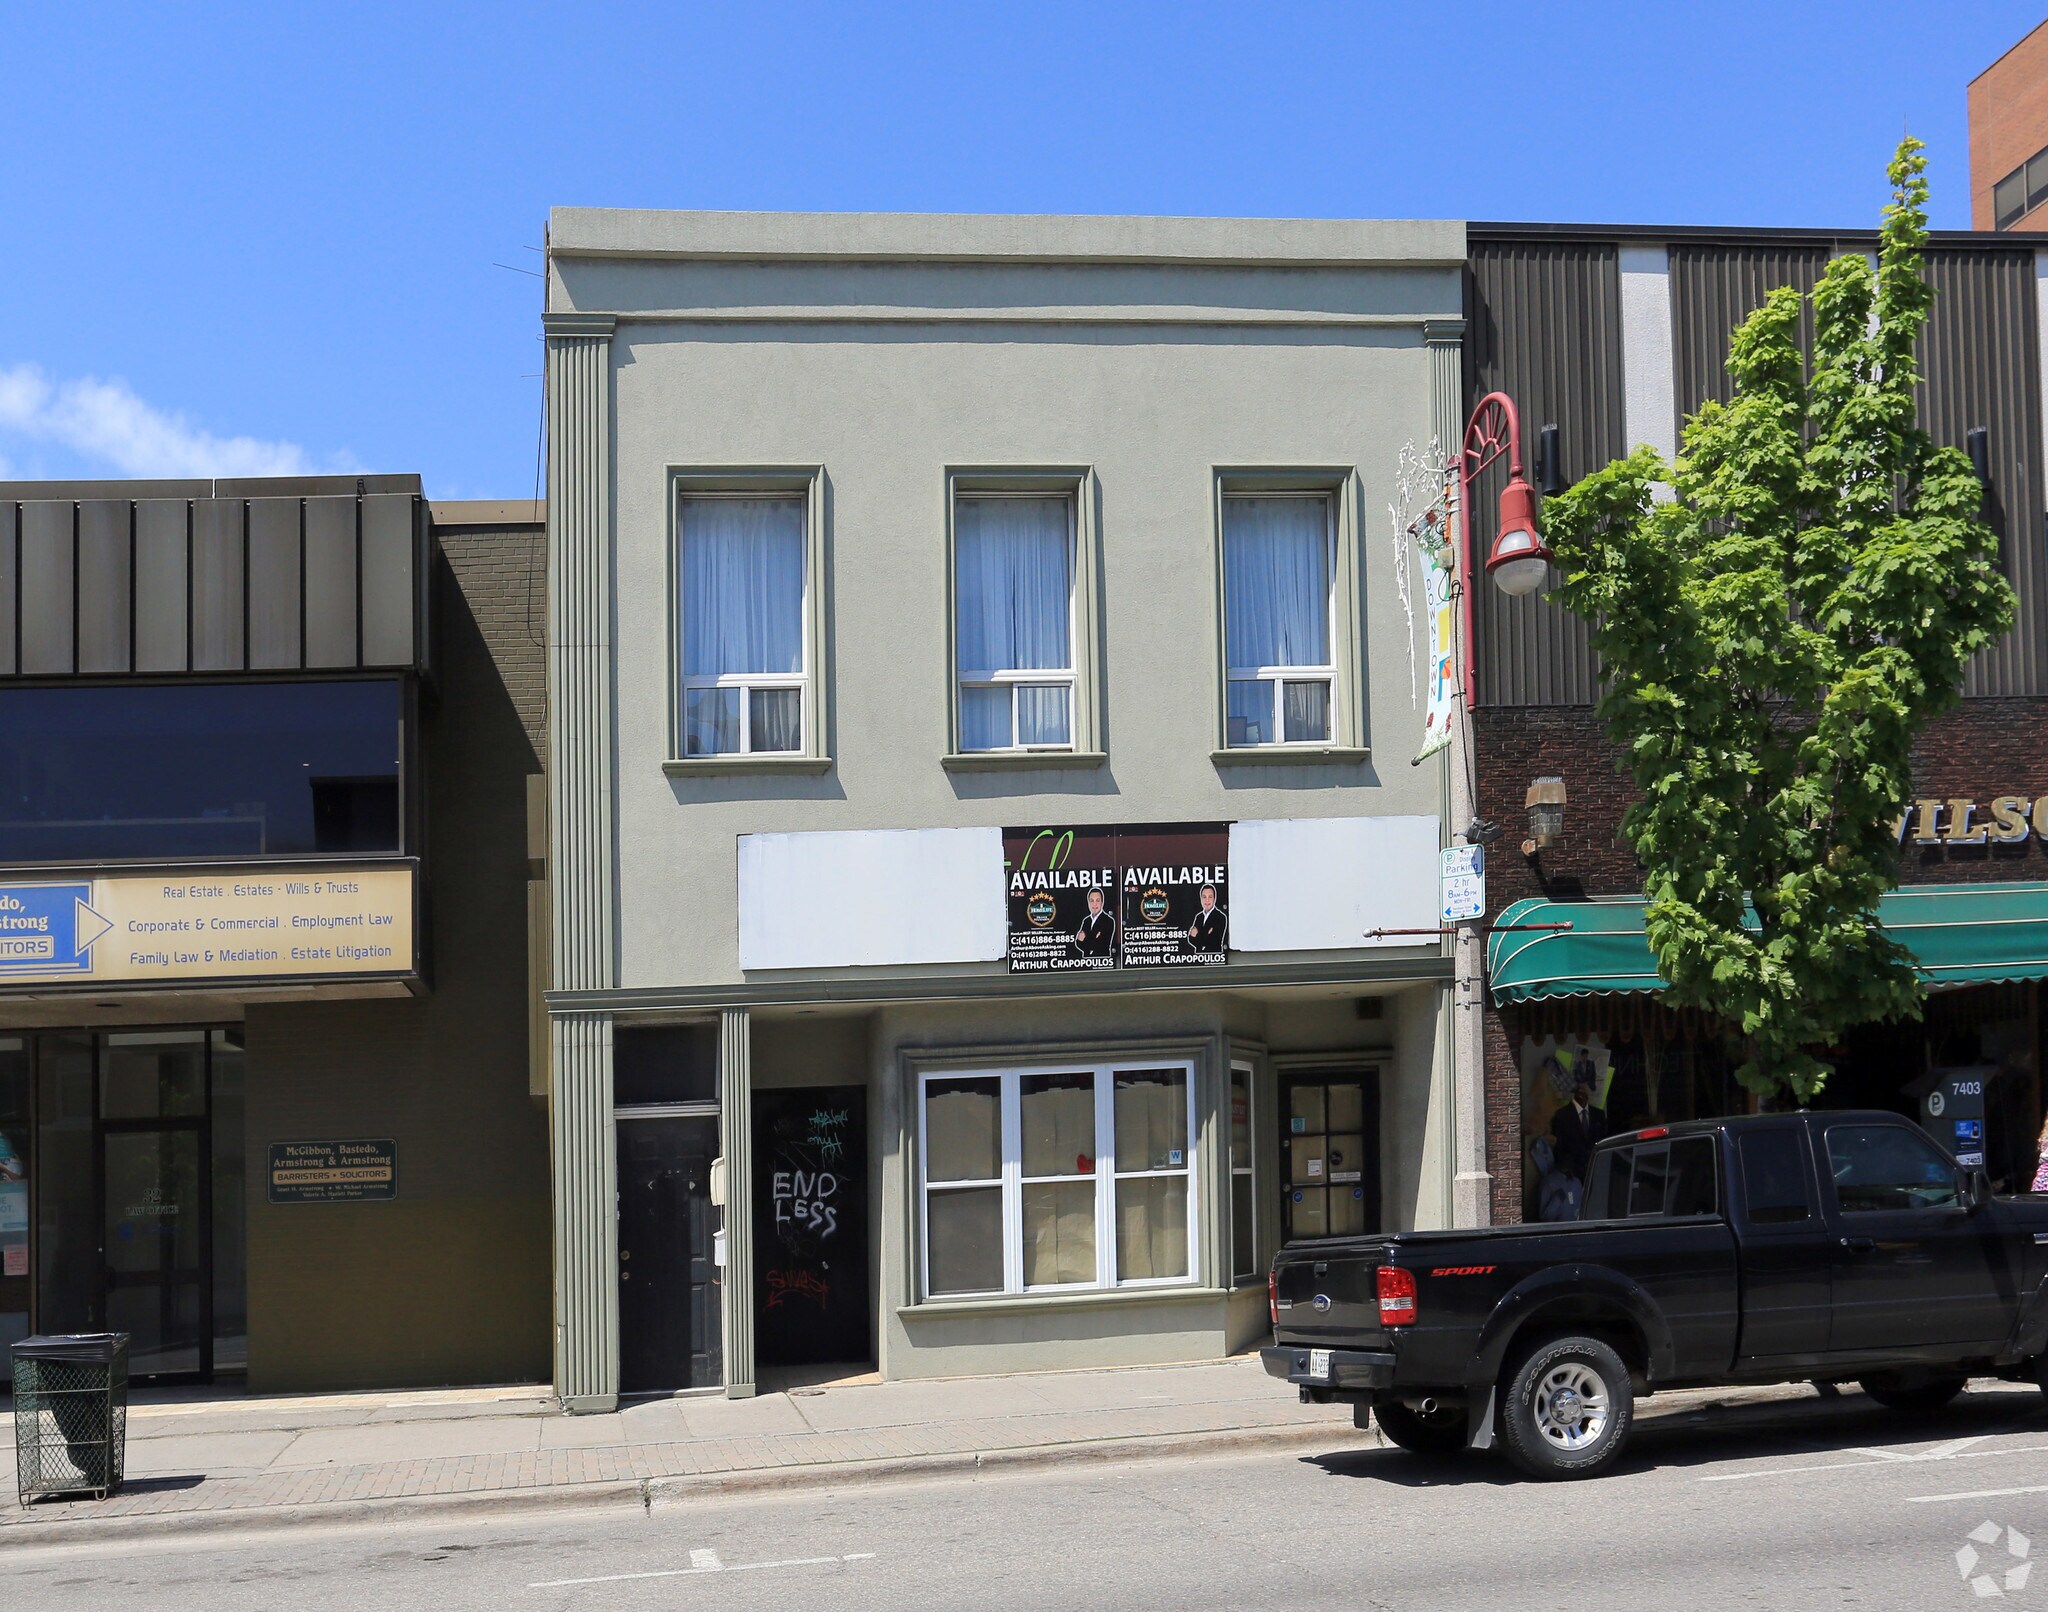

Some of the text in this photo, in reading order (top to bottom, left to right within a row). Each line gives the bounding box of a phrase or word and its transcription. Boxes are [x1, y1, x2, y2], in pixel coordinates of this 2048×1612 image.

[1426, 578, 1438, 699] DOWNTOWN
[1883, 796, 2048, 843] ILS
[1124, 866, 1225, 886] AVAILABLE
[1445, 863, 1479, 874] Parking
[1010, 869, 1113, 890] AVAILABLE
[1454, 878, 1470, 888] 2 hr
[163, 881, 359, 898] Real Estate Estates Wills & Trusts
[0, 914, 49, 931] trong
[128, 913, 393, 934] Corporate & Commercial Employment Law
[1010, 935, 1075, 946] C:(416)886-8885
[130, 945, 392, 966] Family Law & Mediation Estate Litigation
[1952, 1081, 1981, 1096] 7403
[286, 1144, 380, 1157] McGibbon, Bastedo,
[273, 1155, 392, 1169] Armstrong & Armstrong
[277, 1169, 387, 1181] BARRISTERS SOLICITORS
[773, 1170, 837, 1199] END
[775, 1199, 837, 1237] LESS
[1430, 1265, 1497, 1277] SPORT
[1522, 1345, 1597, 1406] GOODYEAR
